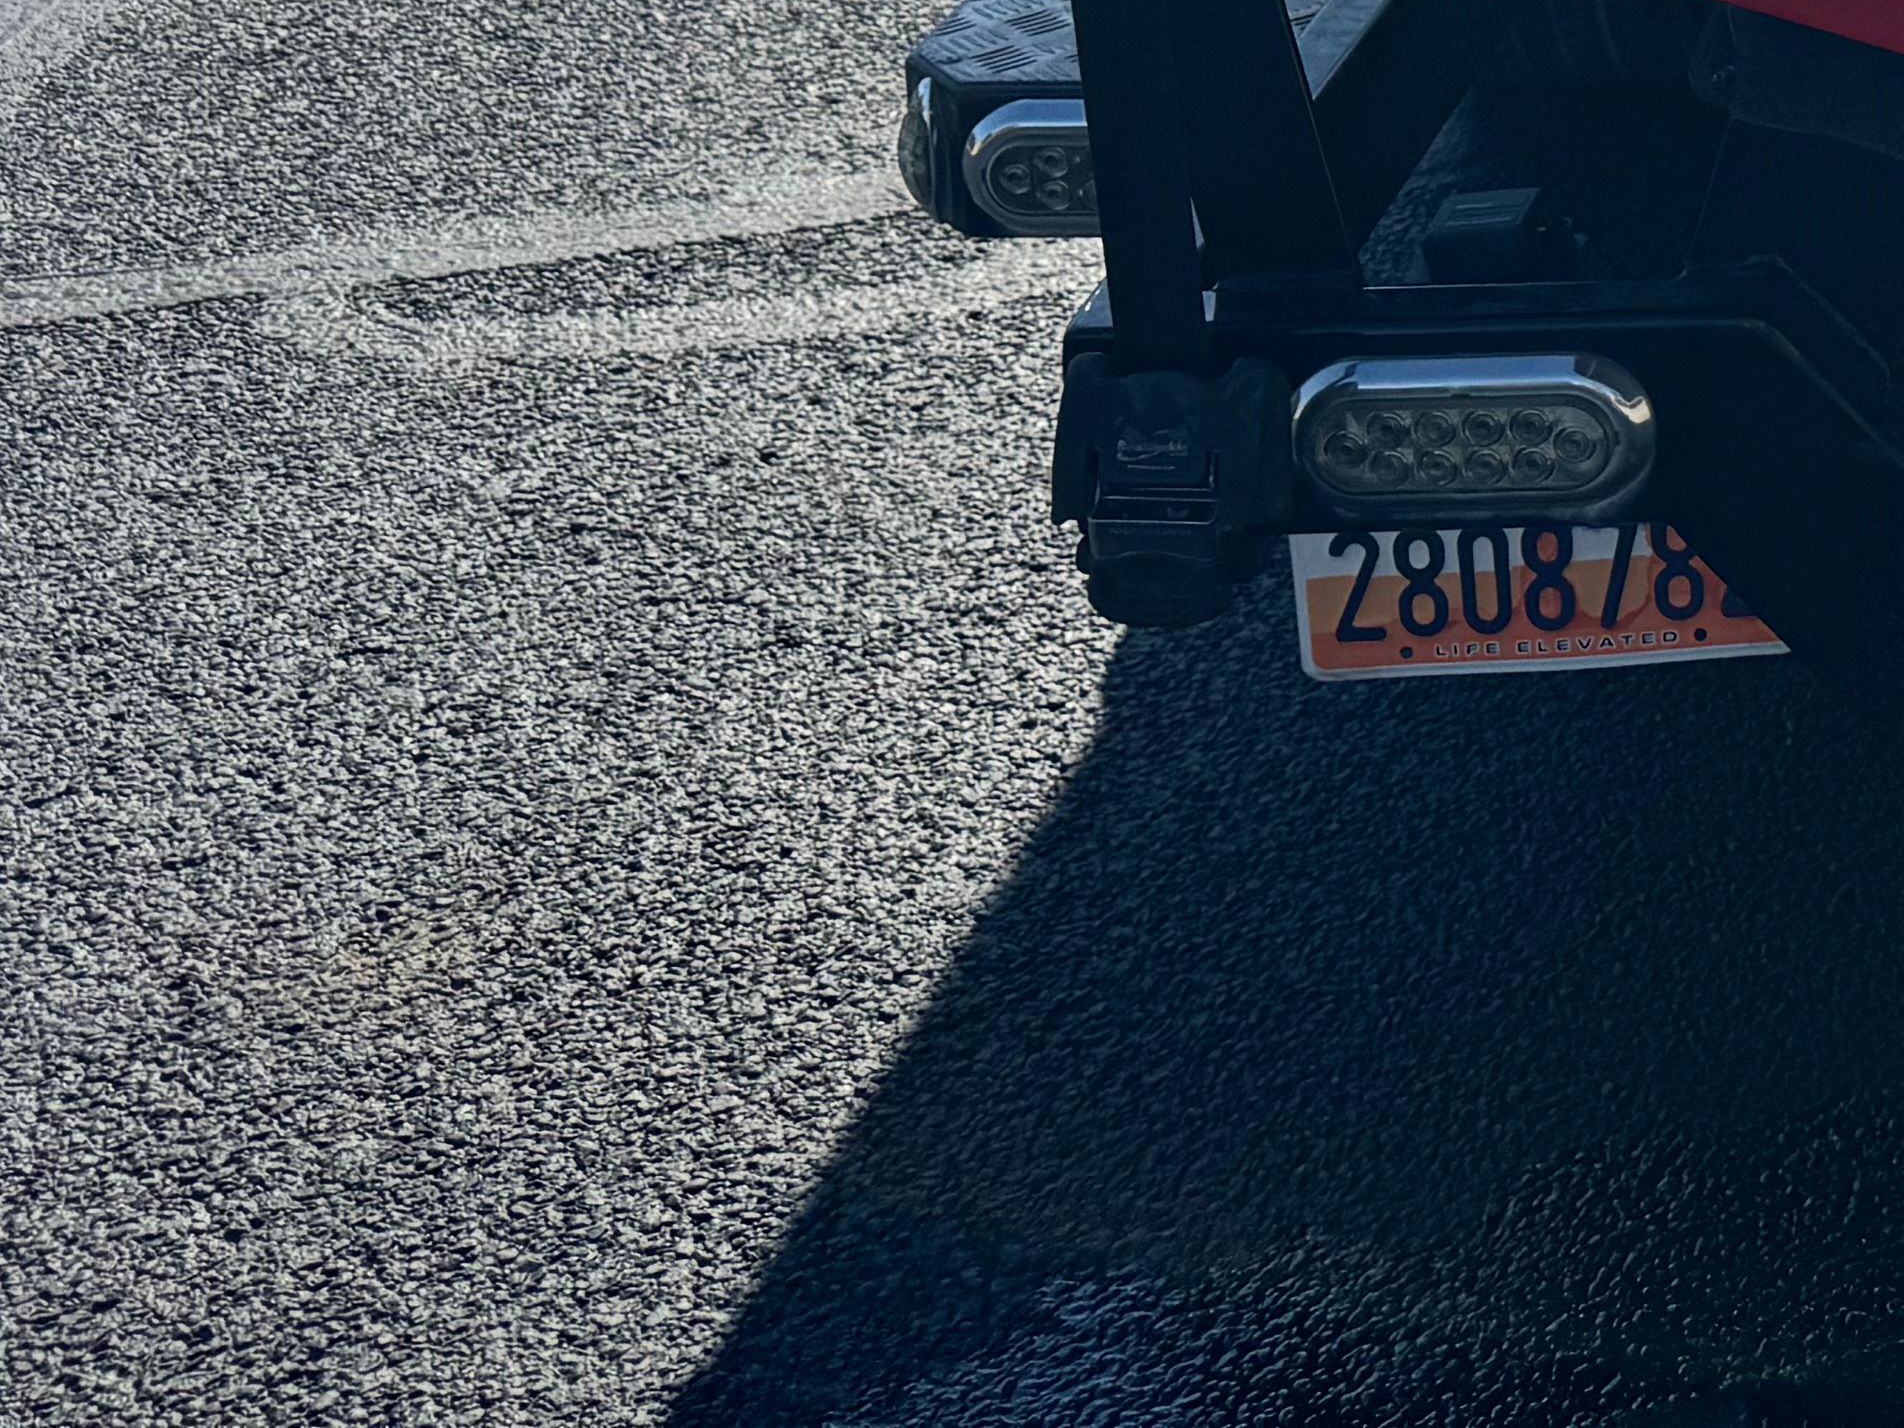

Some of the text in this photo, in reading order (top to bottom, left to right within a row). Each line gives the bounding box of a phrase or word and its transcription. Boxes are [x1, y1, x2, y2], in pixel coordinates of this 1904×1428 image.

[1329, 523, 1757, 642] 280878
[1436, 631, 1679, 657] LIFE ELEVATED
